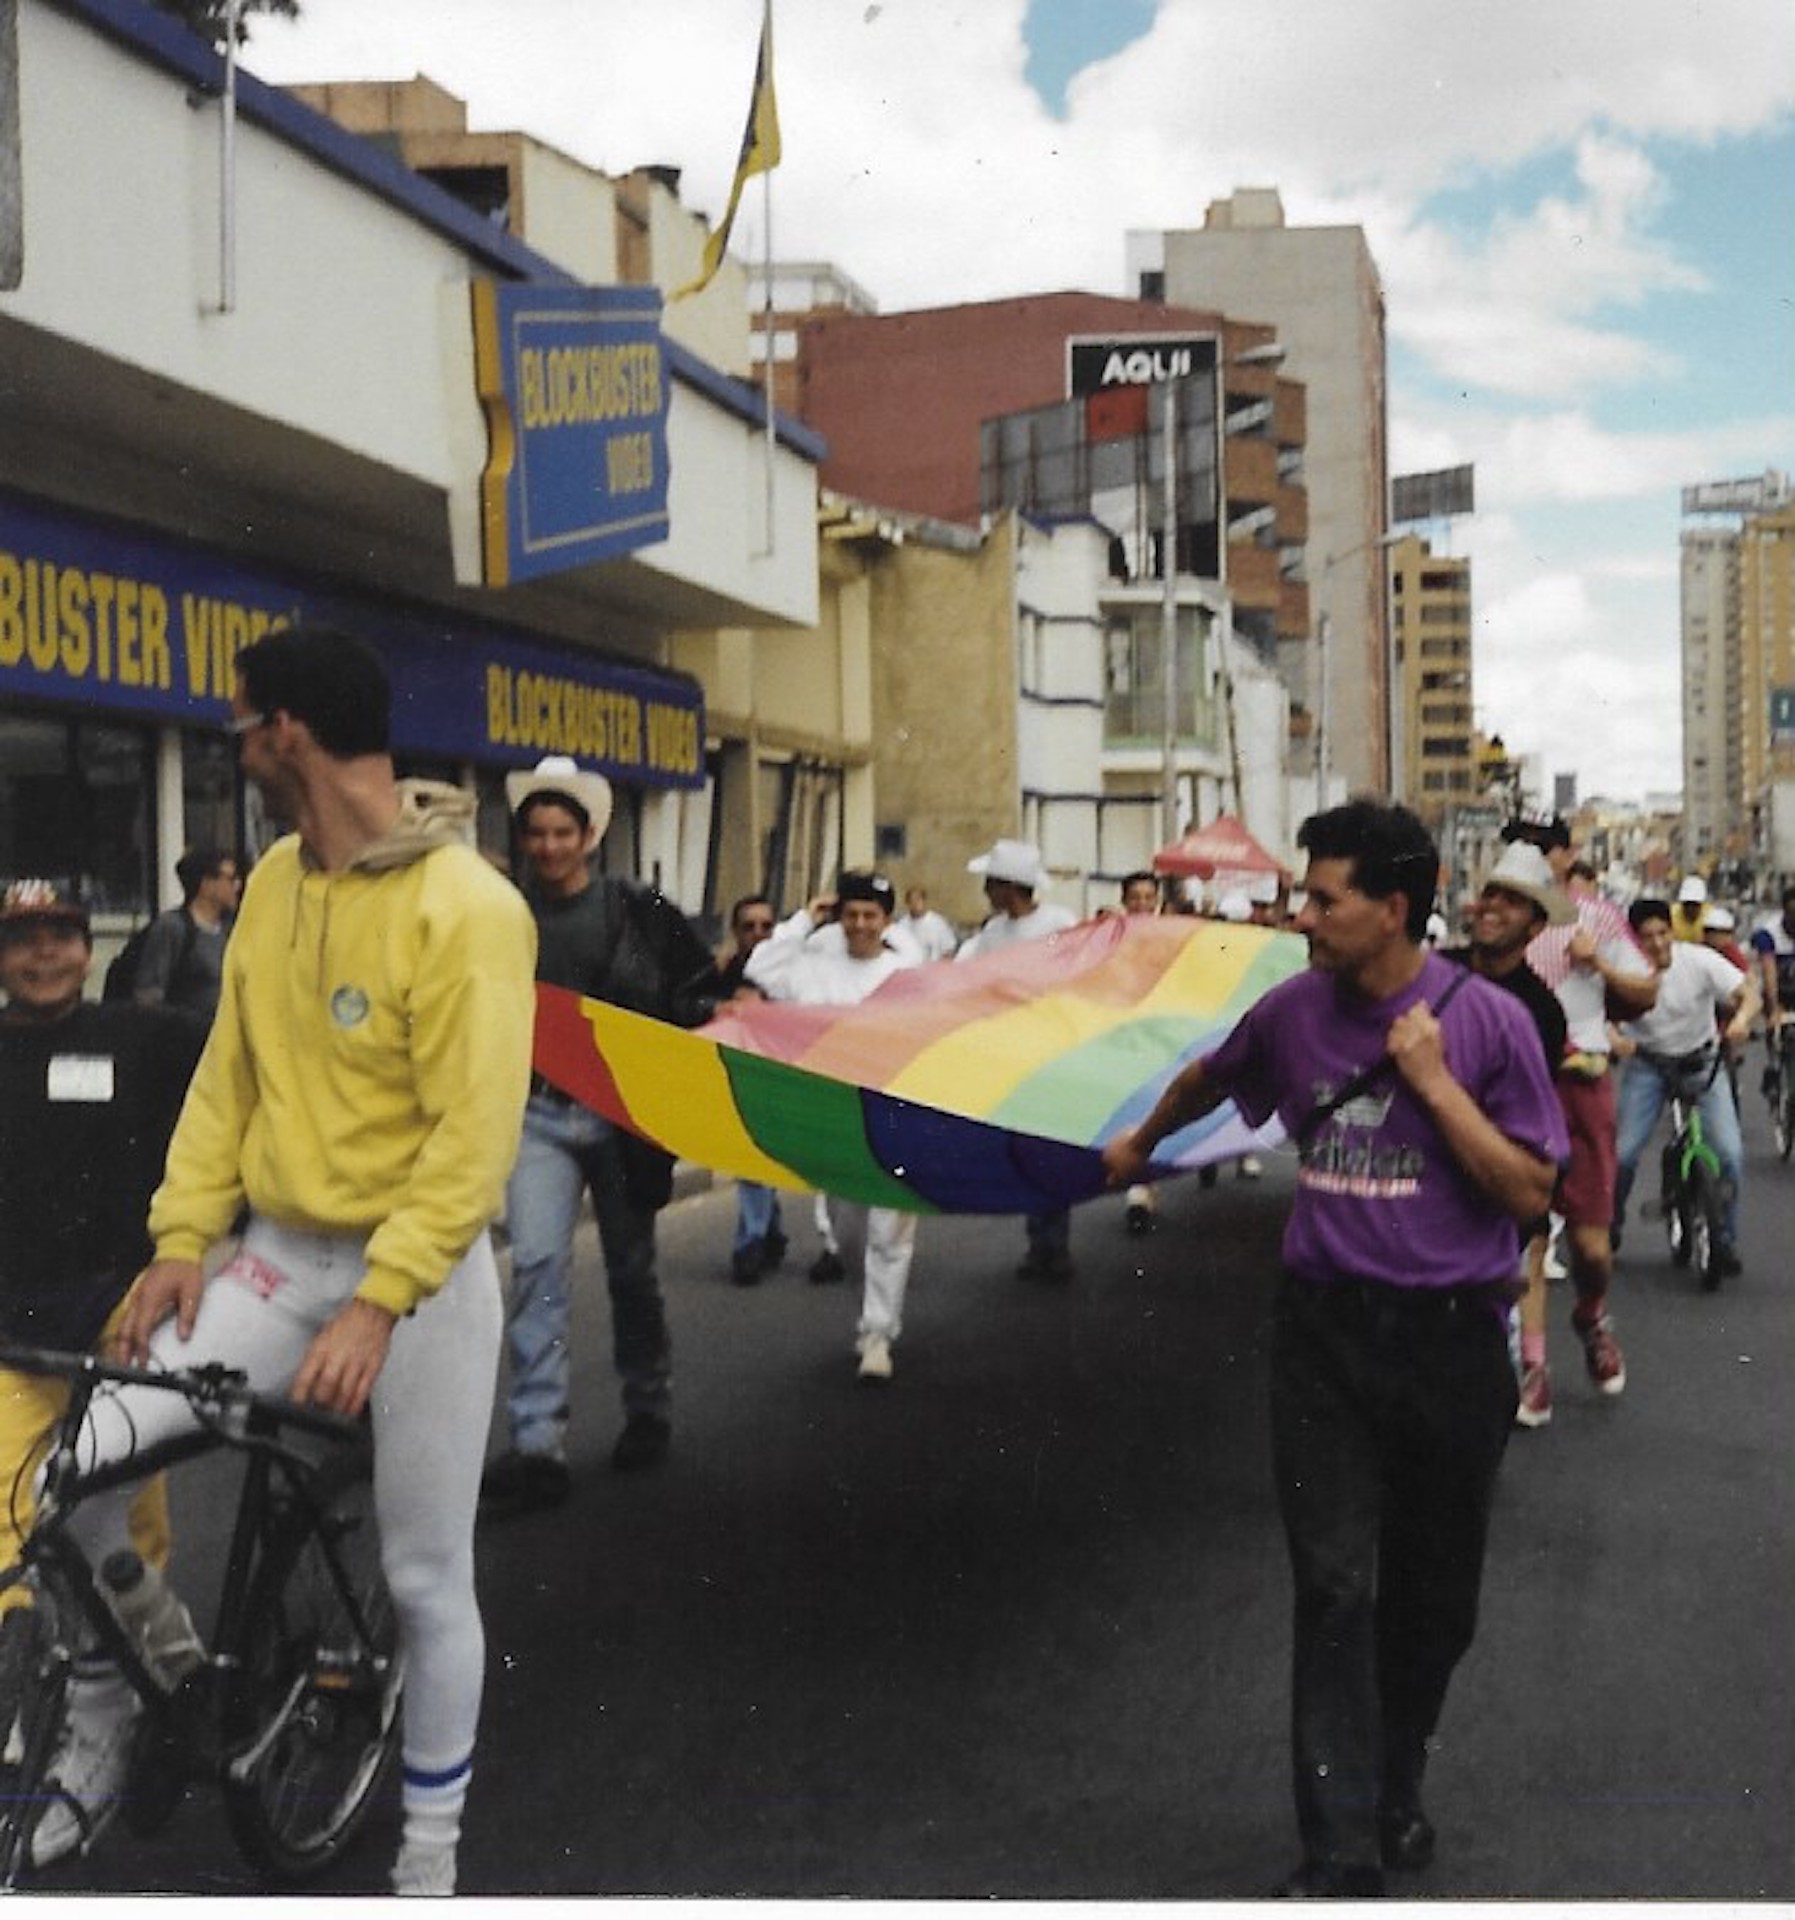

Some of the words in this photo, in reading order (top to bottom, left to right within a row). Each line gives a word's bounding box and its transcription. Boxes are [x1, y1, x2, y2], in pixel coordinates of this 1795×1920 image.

[522, 342, 661, 428] BLOCKBUSTER
[1102, 350, 1191, 383] AQUI
[607, 432, 653, 495] VIDEO
[0, 553, 171, 689] BUSTER
[183, 592, 290, 700] VID
[487, 664, 642, 765] BLOCKBUSTER
[647, 702, 698, 775] VIDEO
